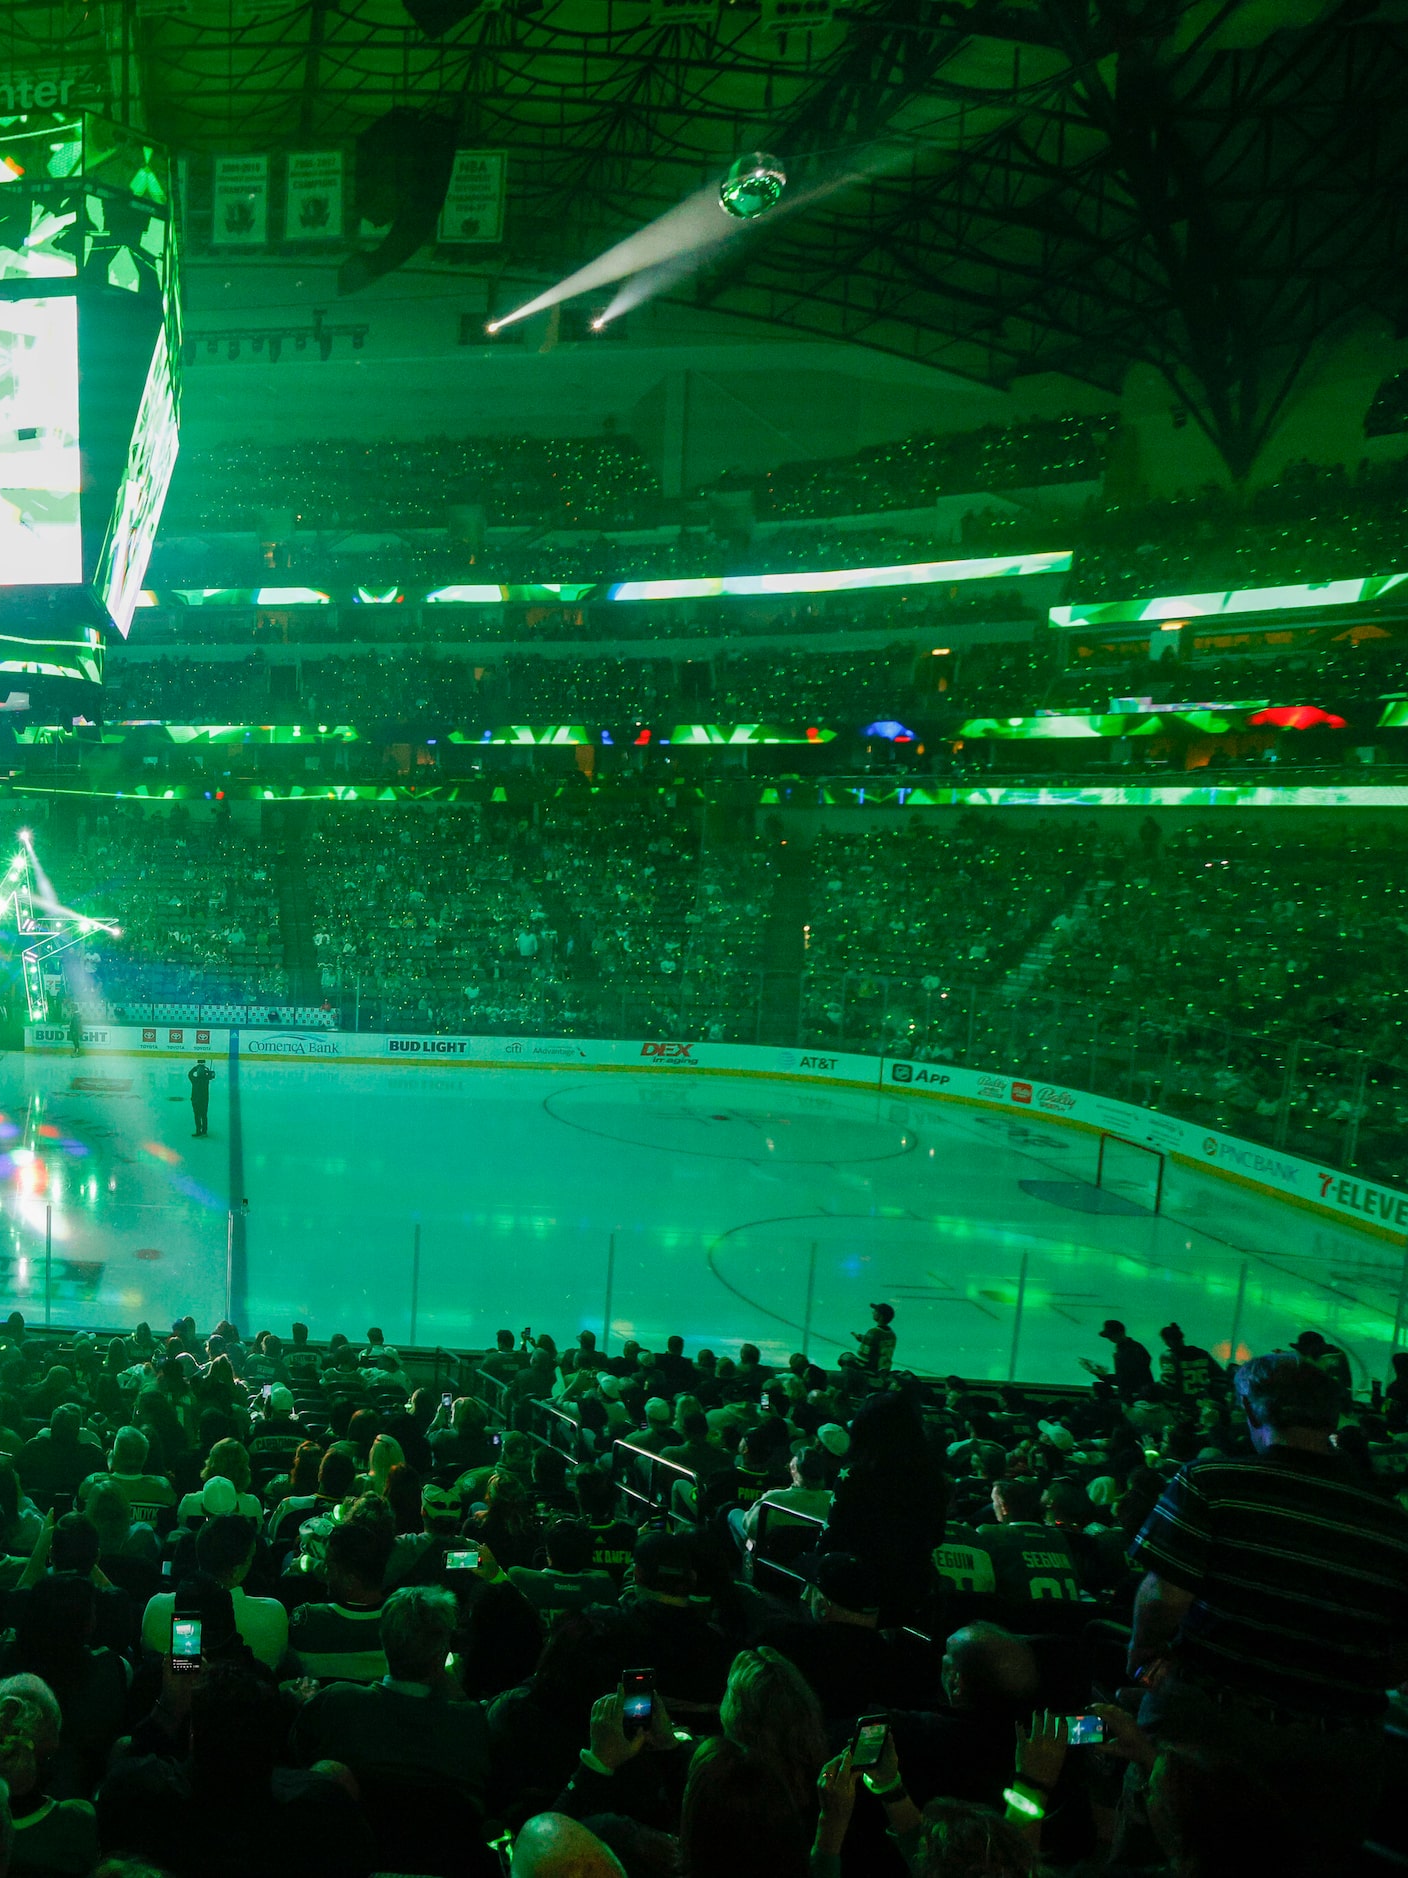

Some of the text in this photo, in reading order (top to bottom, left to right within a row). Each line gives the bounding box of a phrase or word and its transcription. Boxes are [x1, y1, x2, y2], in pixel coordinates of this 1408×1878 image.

[35, 1030, 108, 1042] BUD LGHT
[309, 1042, 339, 1053] Bank
[389, 1040, 467, 1053] BUD LIGHT
[641, 1043, 695, 1057] DEX
[800, 1056, 838, 1070] AT&T
[933, 1551, 974, 1570] EGUIN
[1022, 1551, 1073, 1569] SEGUIN
